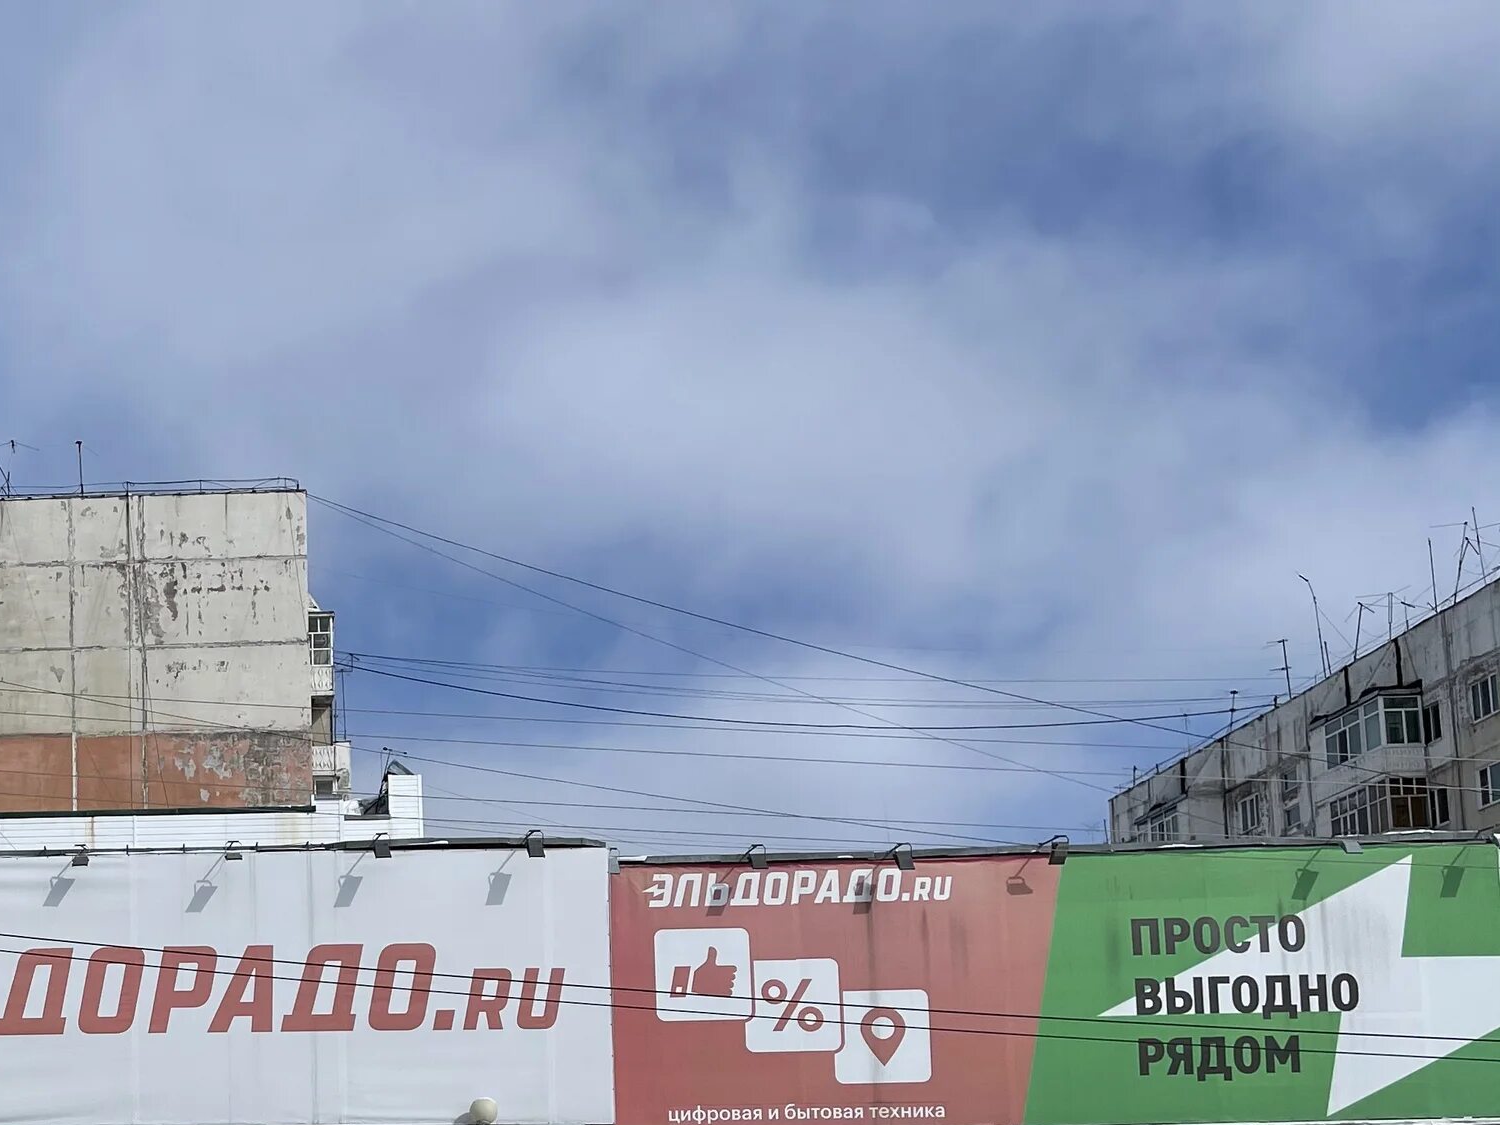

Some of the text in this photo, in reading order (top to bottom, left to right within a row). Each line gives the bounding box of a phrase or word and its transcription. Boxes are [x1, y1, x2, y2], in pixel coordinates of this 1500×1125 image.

[642, 868, 952, 908] ЭЛЬДОРАДО.RU
[1131, 914, 1306, 955] ПРОСТО
[1135, 973, 1359, 1019] ВЫГОДНО
[1138, 1035, 1301, 1081] РЯДОМ
[668, 1104, 946, 1125] цифровая и бытовая техника
